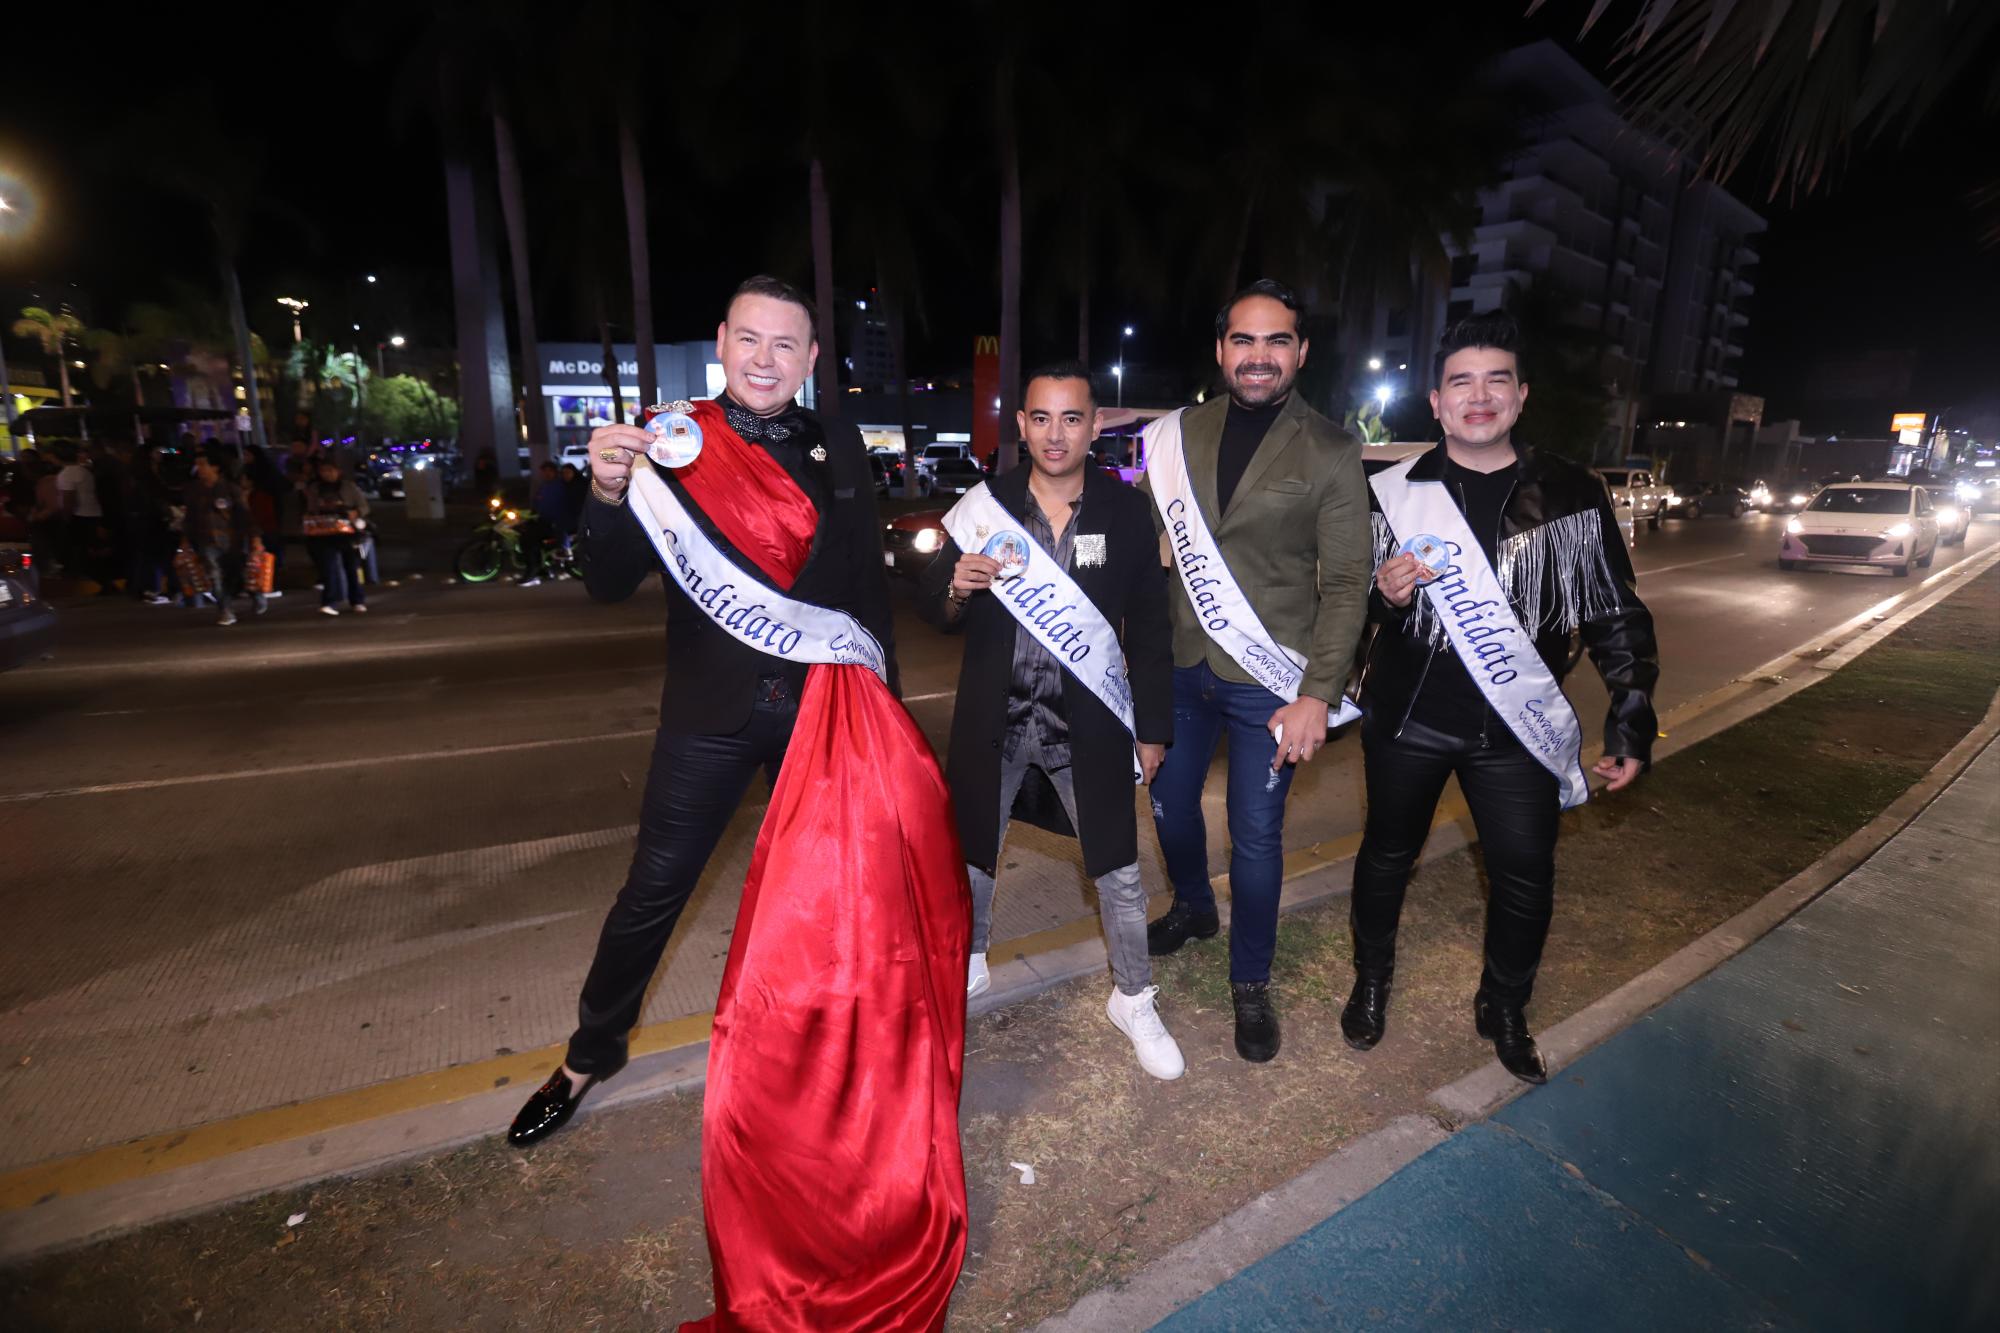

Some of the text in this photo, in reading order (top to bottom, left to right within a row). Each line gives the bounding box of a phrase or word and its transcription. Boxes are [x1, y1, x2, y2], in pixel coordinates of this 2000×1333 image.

[549, 360, 639, 375] McDold
[663, 529, 802, 655] Candidato
[1166, 499, 1229, 631] Candidato
[994, 574, 1090, 663] ndidato
[1246, 645, 1296, 690] Carnaval
[1525, 700, 1567, 752] Carnaval
